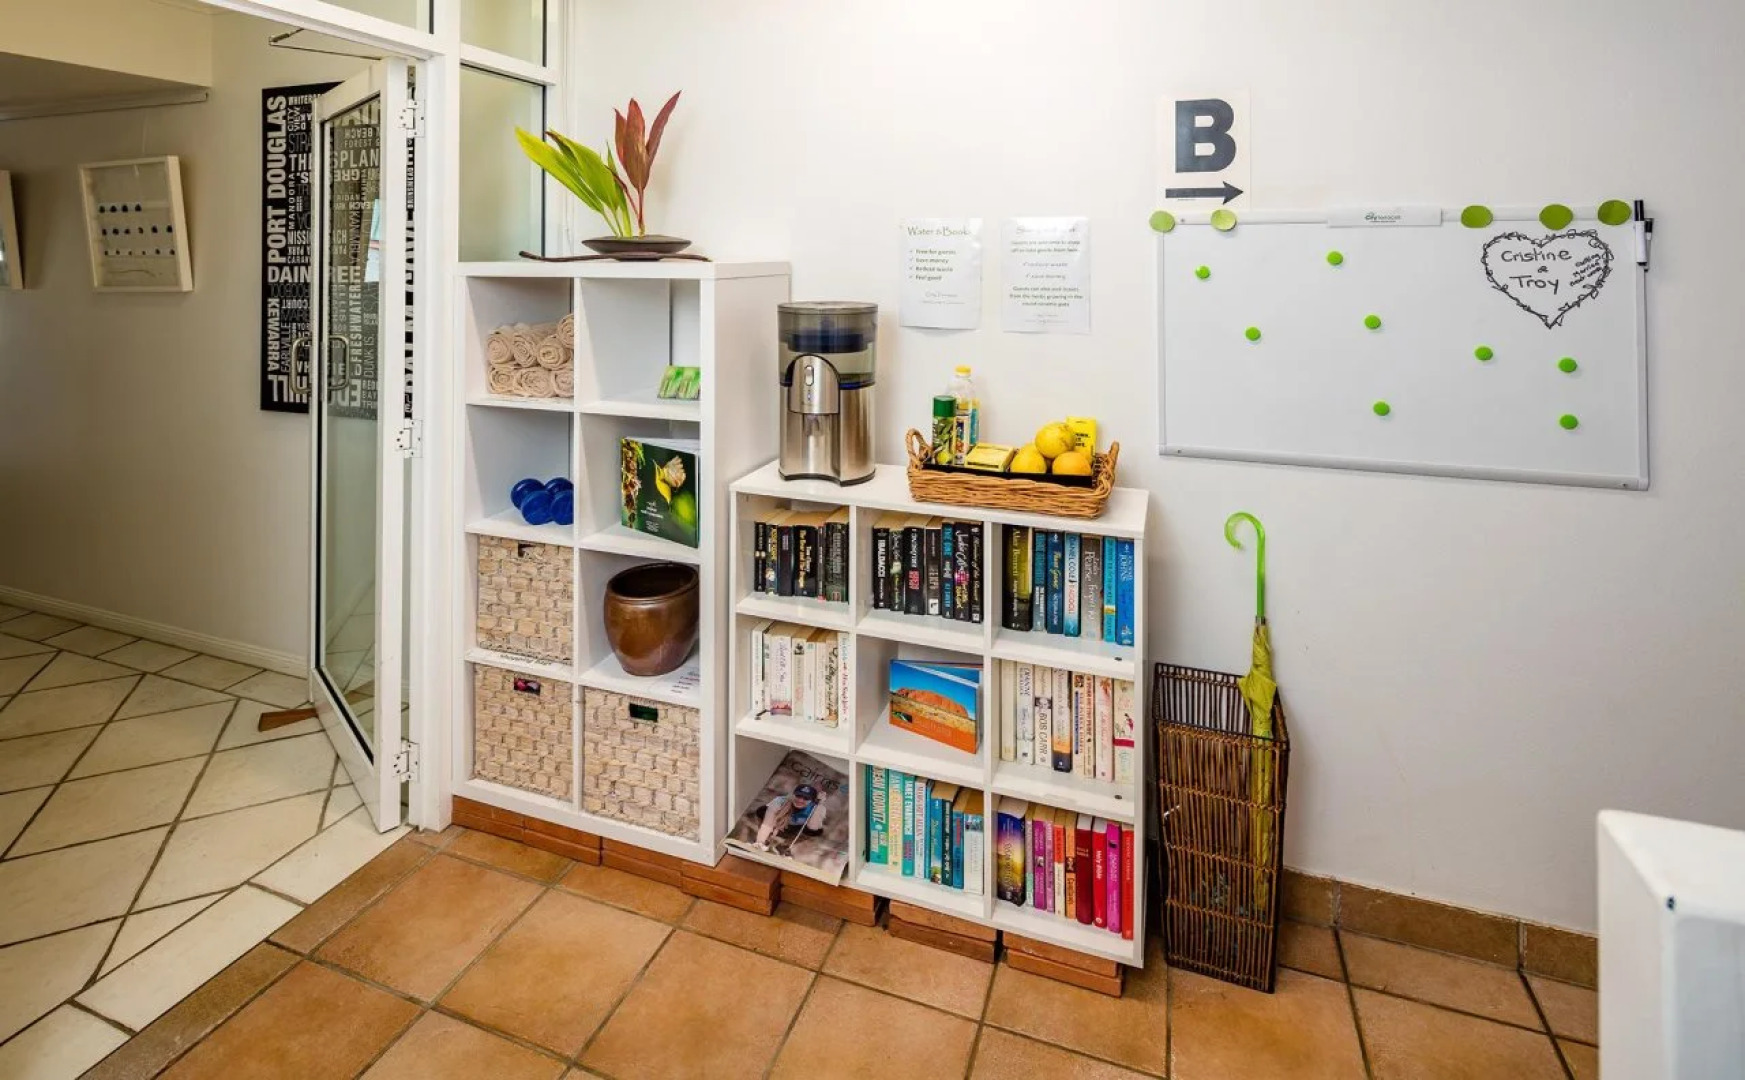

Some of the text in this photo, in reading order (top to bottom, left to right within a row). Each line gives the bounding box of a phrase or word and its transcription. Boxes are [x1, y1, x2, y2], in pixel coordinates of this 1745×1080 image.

[1175, 98, 1237, 173] B
[266, 95, 287, 264] PORT DOUGLAS
[288, 172, 296, 230] MANOORA
[907, 225, 935, 237] Water
[1501, 247, 1573, 263] Cristine
[1508, 274, 1560, 295] Troy
[267, 298, 280, 372] KEWARRA
[348, 284, 362, 363] FRESHWATER
[363, 349, 375, 378] DUNK
[1038, 711, 1048, 755] BOB CARR
[872, 789, 886, 824] KOONTZ
